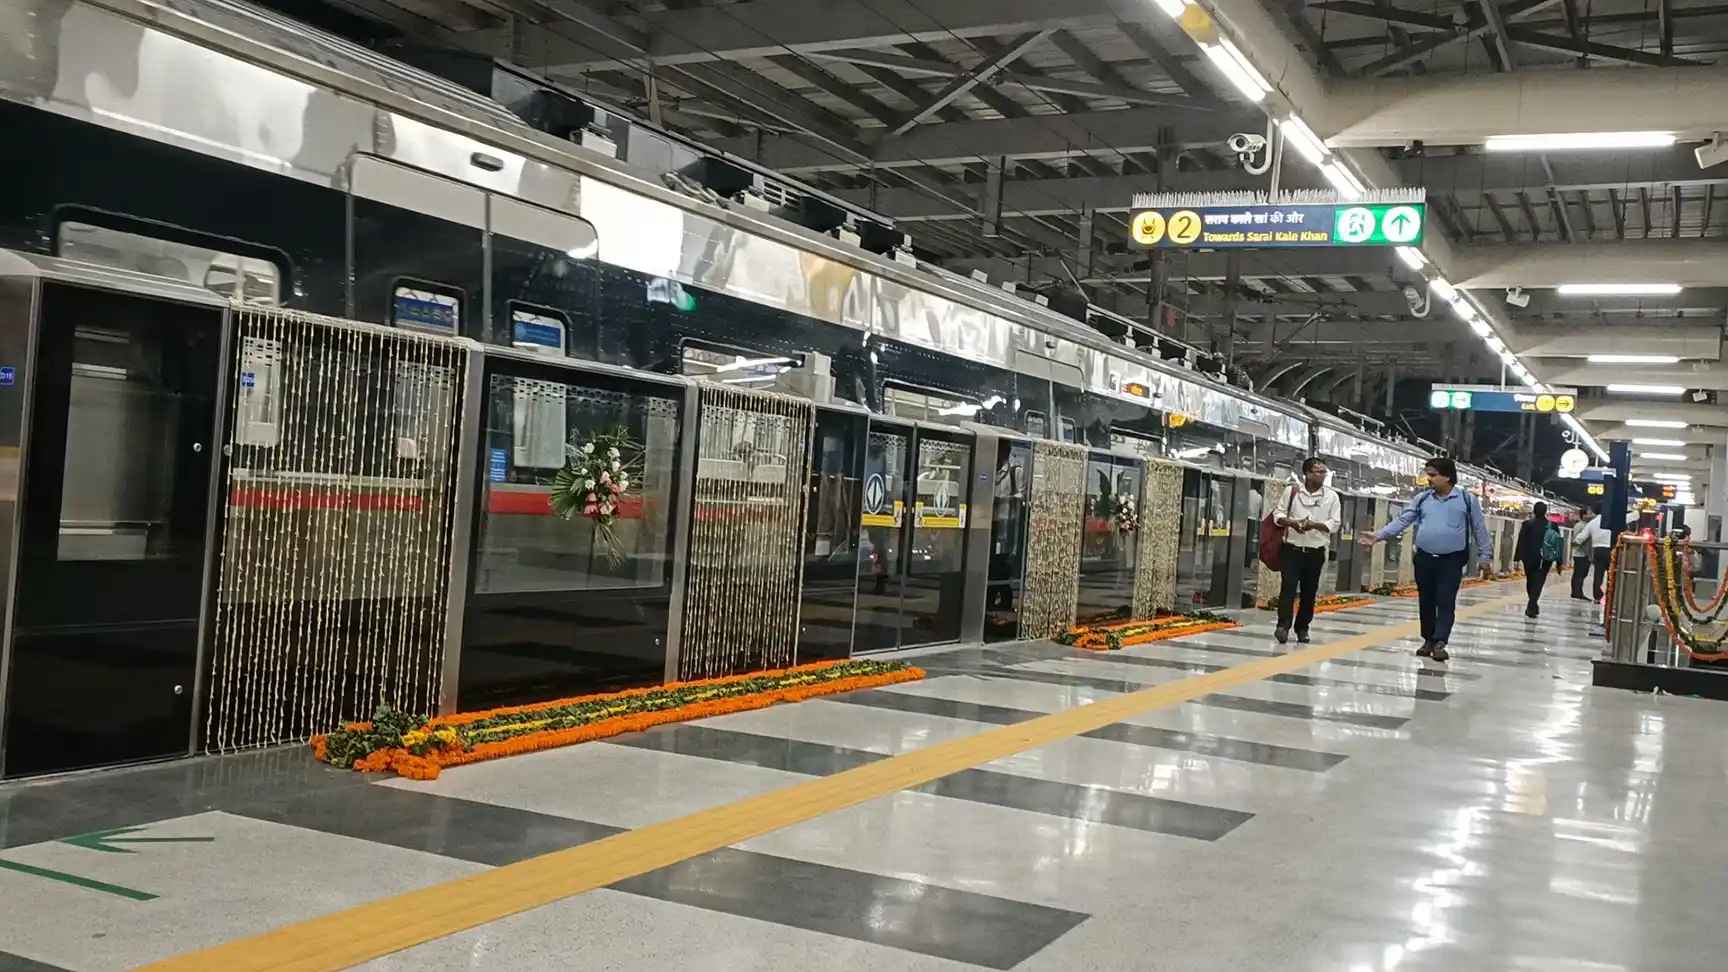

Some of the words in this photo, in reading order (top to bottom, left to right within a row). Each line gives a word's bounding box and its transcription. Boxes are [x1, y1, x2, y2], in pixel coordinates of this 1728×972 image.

[1270, 211, 1284, 224] की
[1177, 215, 1192, 238] 2
[1204, 232, 1245, 242] Towards
[1247, 231, 1273, 242] Sarai
[1275, 232, 1298, 241] Kale
[1301, 231, 1327, 241] Khan
